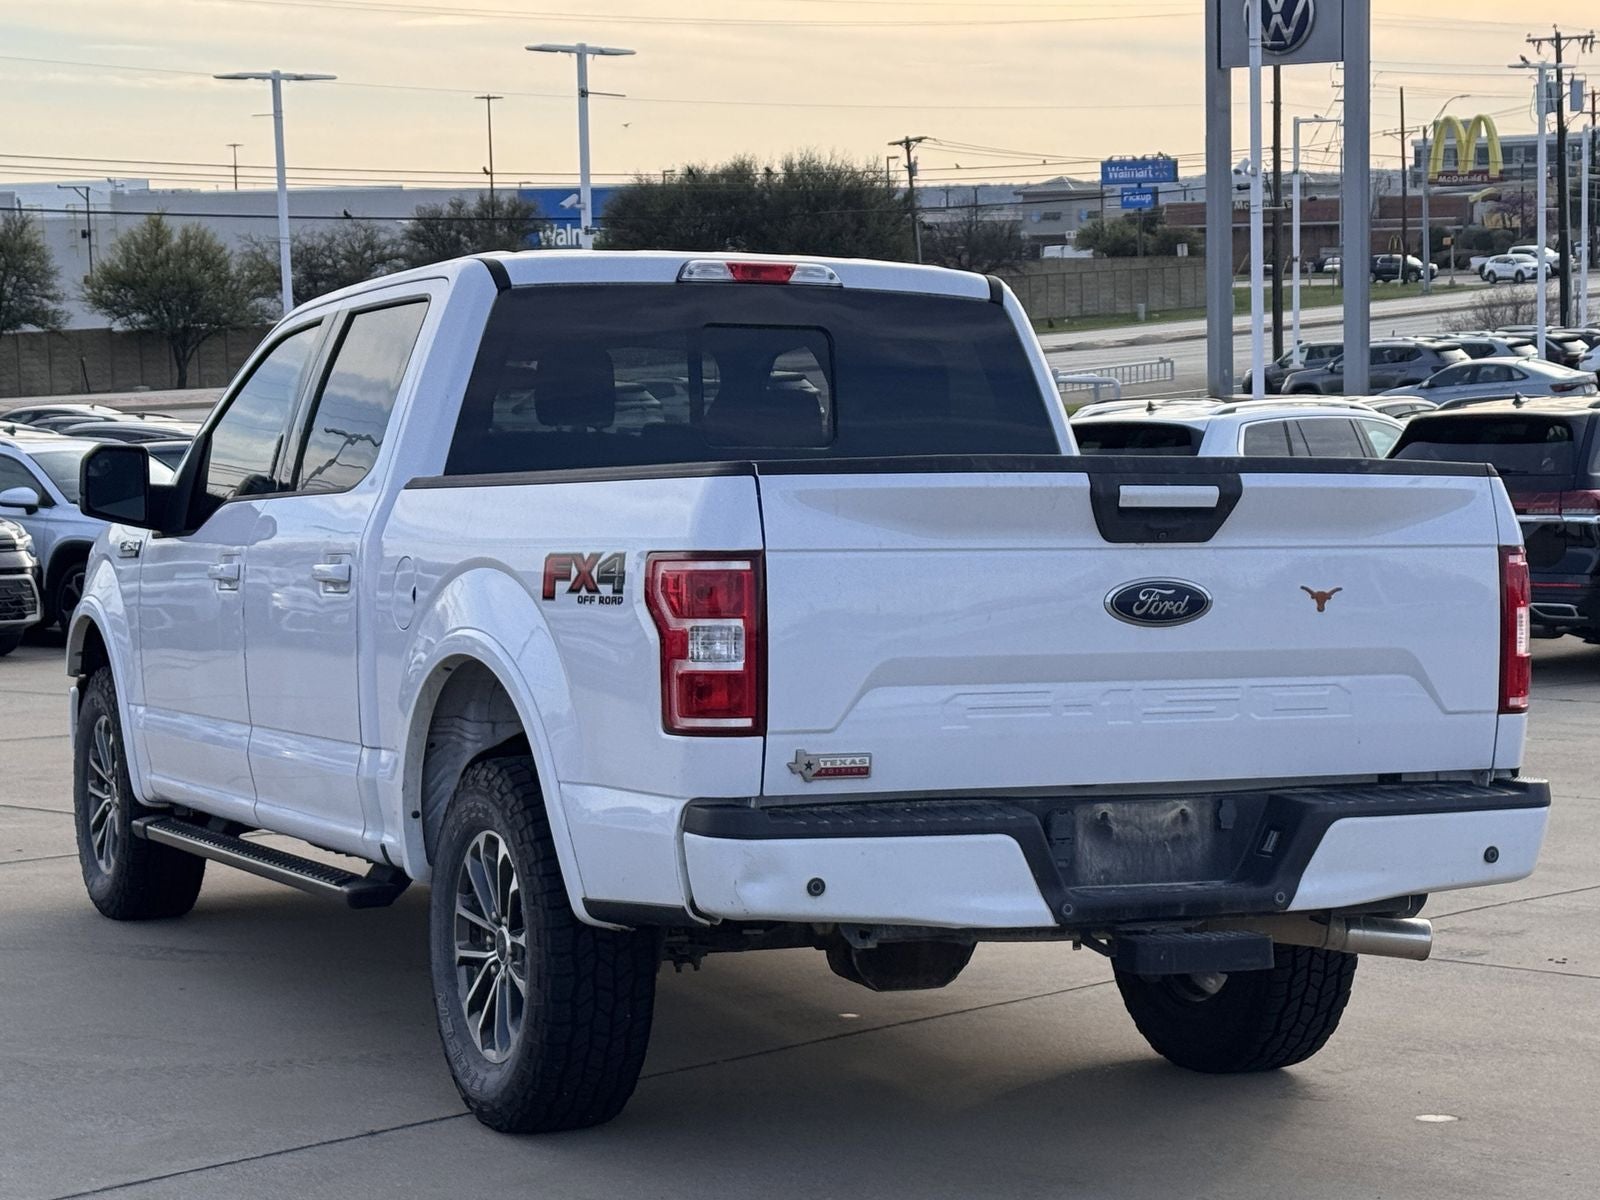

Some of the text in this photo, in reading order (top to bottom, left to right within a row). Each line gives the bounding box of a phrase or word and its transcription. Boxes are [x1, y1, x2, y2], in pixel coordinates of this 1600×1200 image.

[1107, 166, 1153, 178] Walmart
[1123, 191, 1152, 204] Pickup
[542, 552, 626, 601] FX4
[577, 595, 624, 606] OFF ROAD
[1132, 587, 1189, 615] Ford
[820, 758, 868, 766] TEXAS
